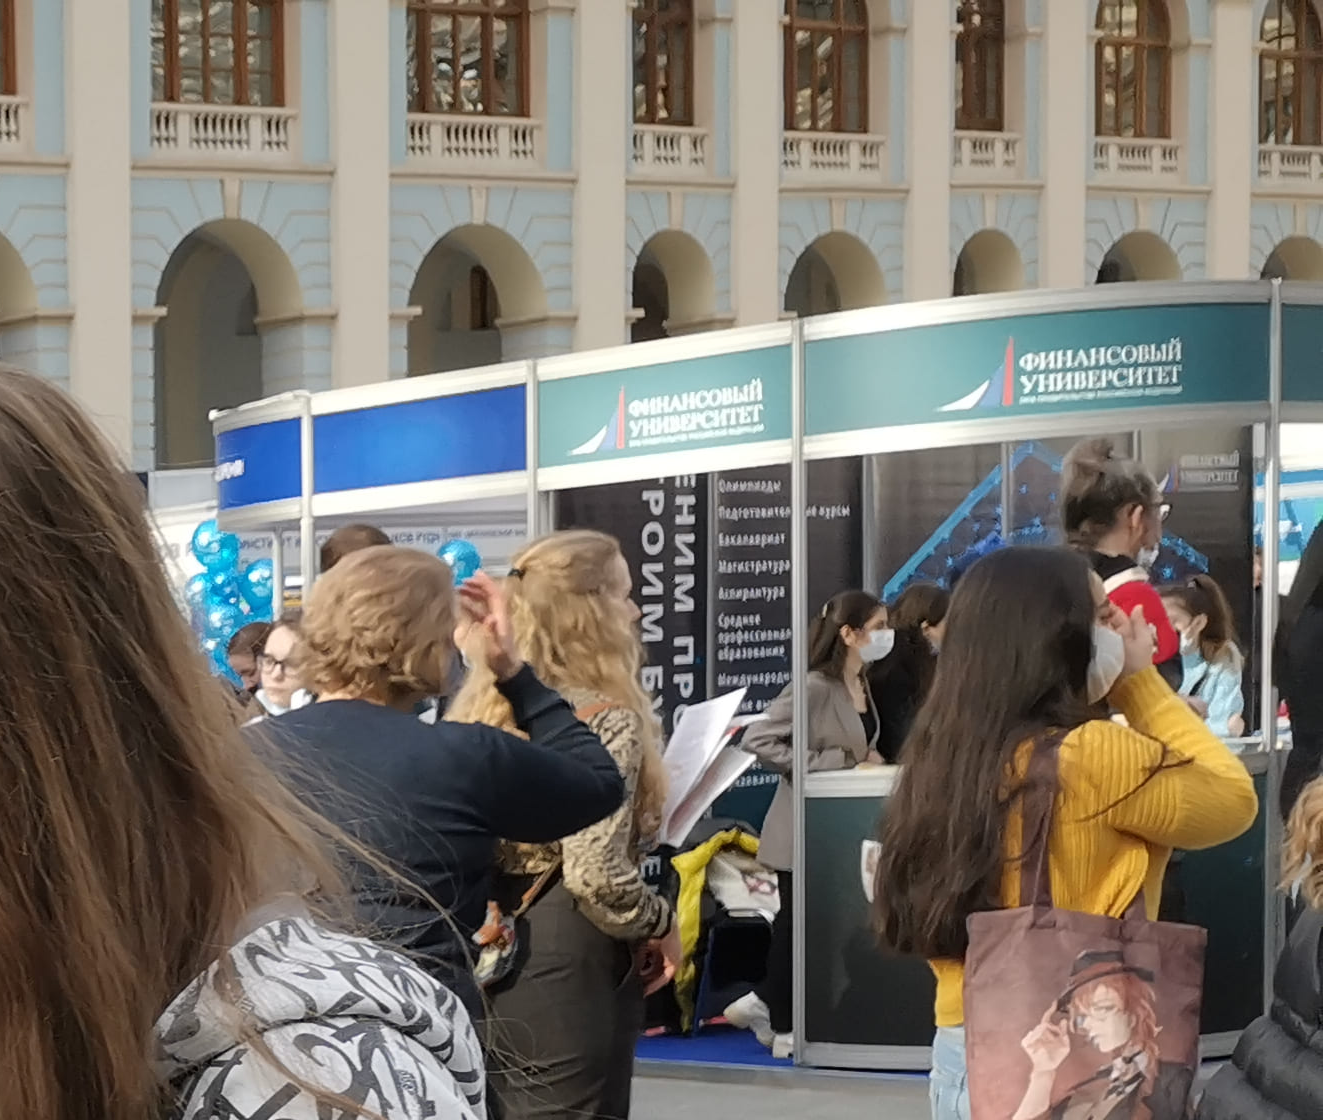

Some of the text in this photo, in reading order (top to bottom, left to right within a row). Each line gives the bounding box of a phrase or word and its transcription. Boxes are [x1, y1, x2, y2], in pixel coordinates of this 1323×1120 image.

[1018, 337, 1183, 371] ФИНАНСОВЫЙ
[1019, 364, 1183, 394] УНИВЕРСИТЕТ
[628, 378, 763, 417] ФИНАНСОВЫЙ
[628, 403, 764, 438] УНИВЕРСИТЕТ
[641, 477, 665, 643] РОИМ
